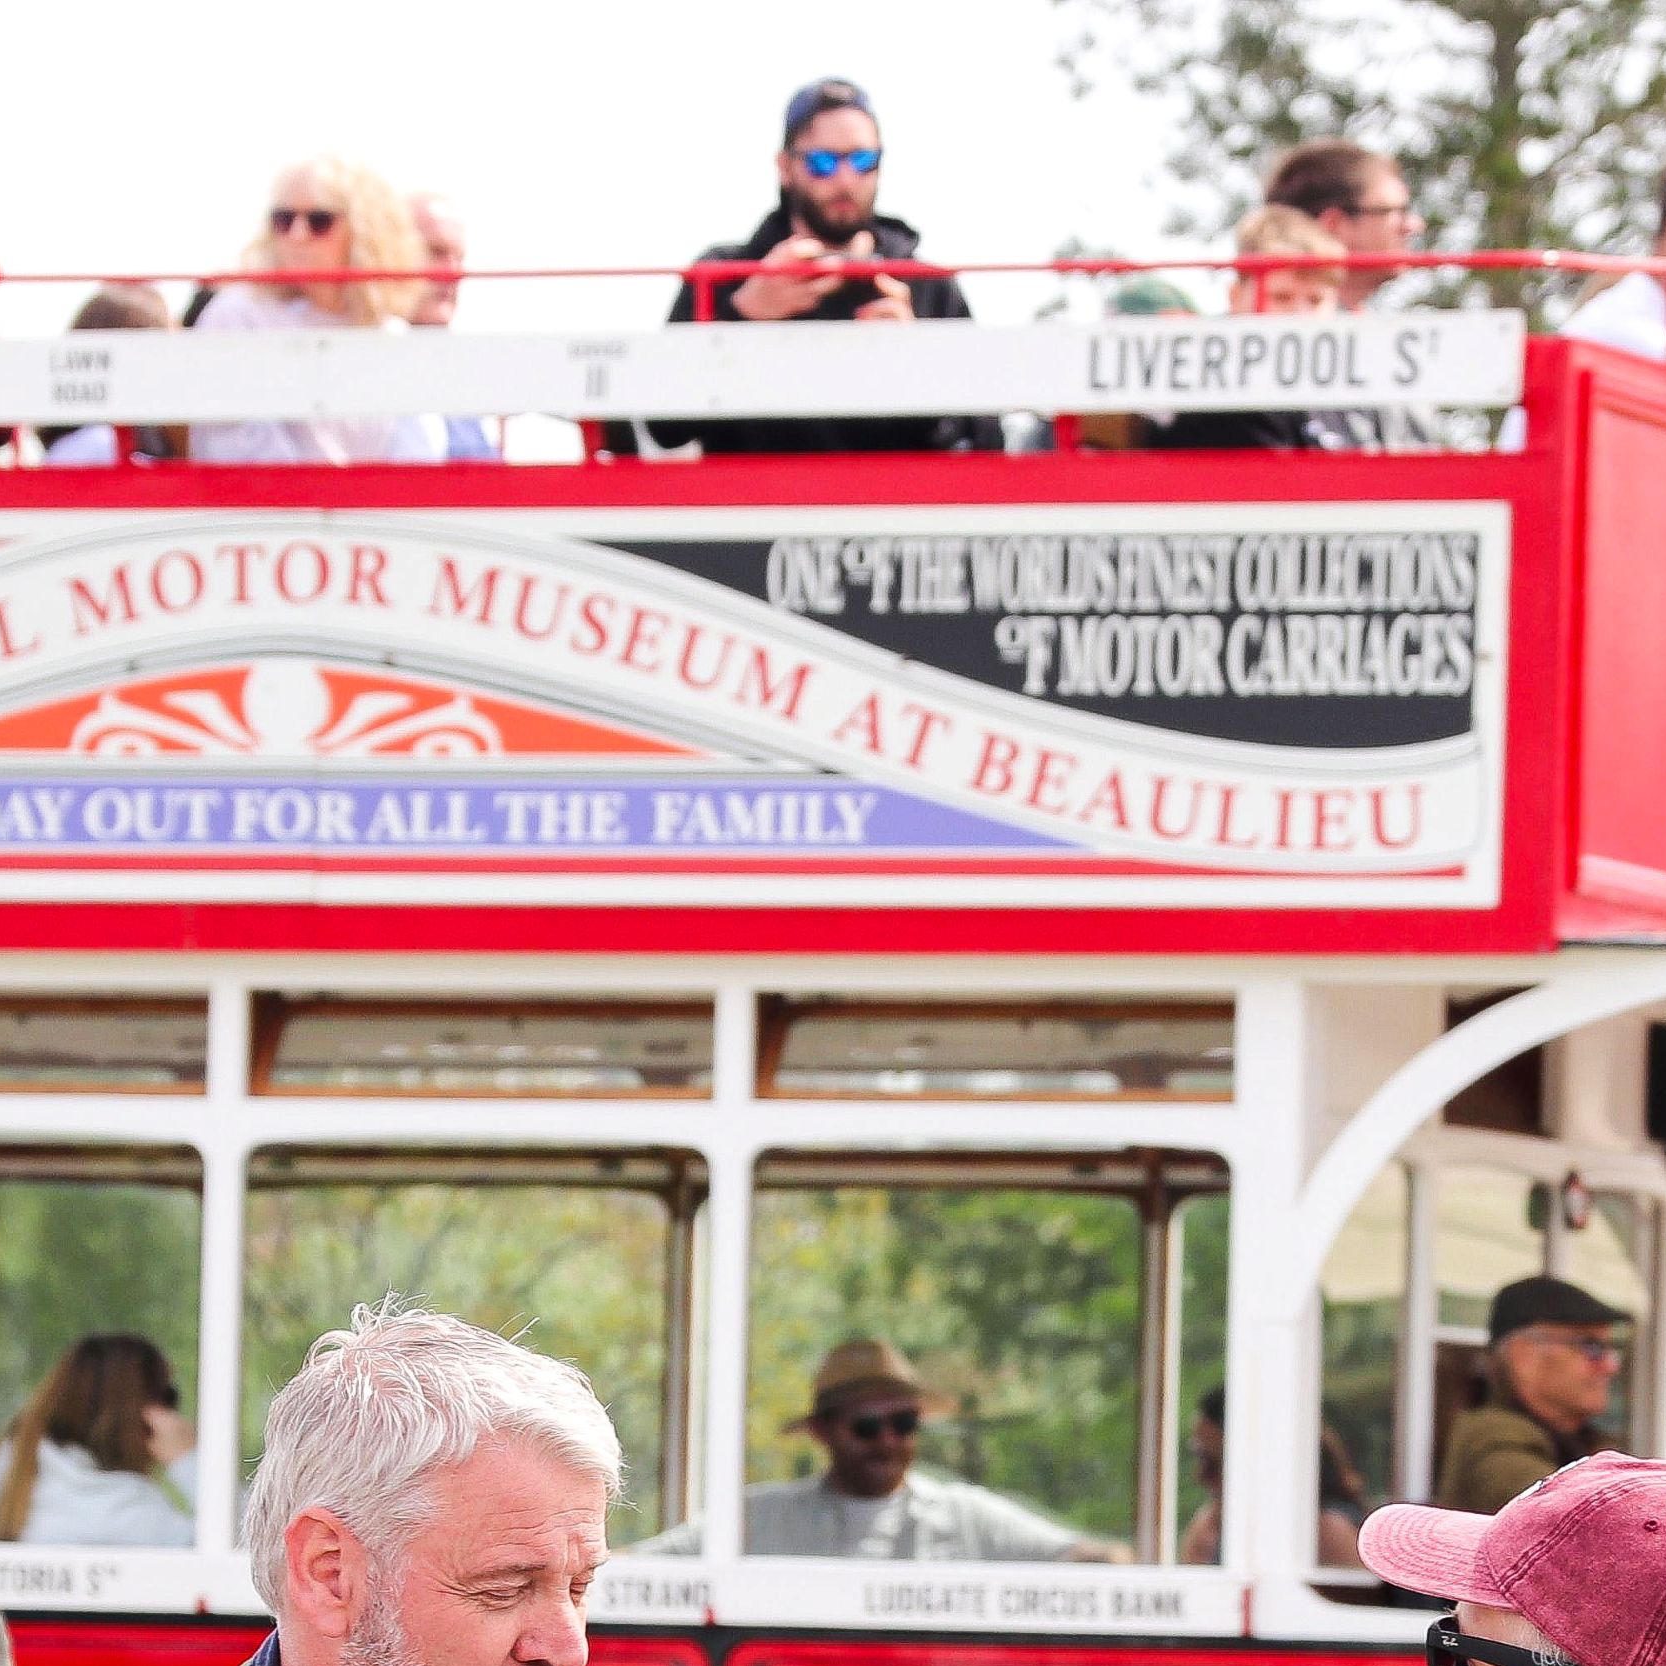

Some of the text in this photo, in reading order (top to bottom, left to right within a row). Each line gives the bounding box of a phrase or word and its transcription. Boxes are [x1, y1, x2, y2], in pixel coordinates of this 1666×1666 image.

[1088, 331, 1366, 391] LIVERPOOL
[767, 538, 845, 614] ONE
[1236, 536, 1475, 613] COLLECTIONS
[1056, 613, 1225, 697] MOTOR
[1226, 613, 1474, 697] CARRIAGES
[67, 541, 391, 636] MOTOR
[428, 557, 817, 723] MUSEUM
[835, 689, 956, 772] AT
[967, 732, 1426, 854] BEAULIEU
[83, 788, 224, 843] OUT
[227, 789, 365, 843] FOR
[366, 789, 484, 843] ALL
[493, 791, 635, 844] THE
[652, 792, 878, 845] FAMILY
[1110, 1586, 1187, 1622] BANK
